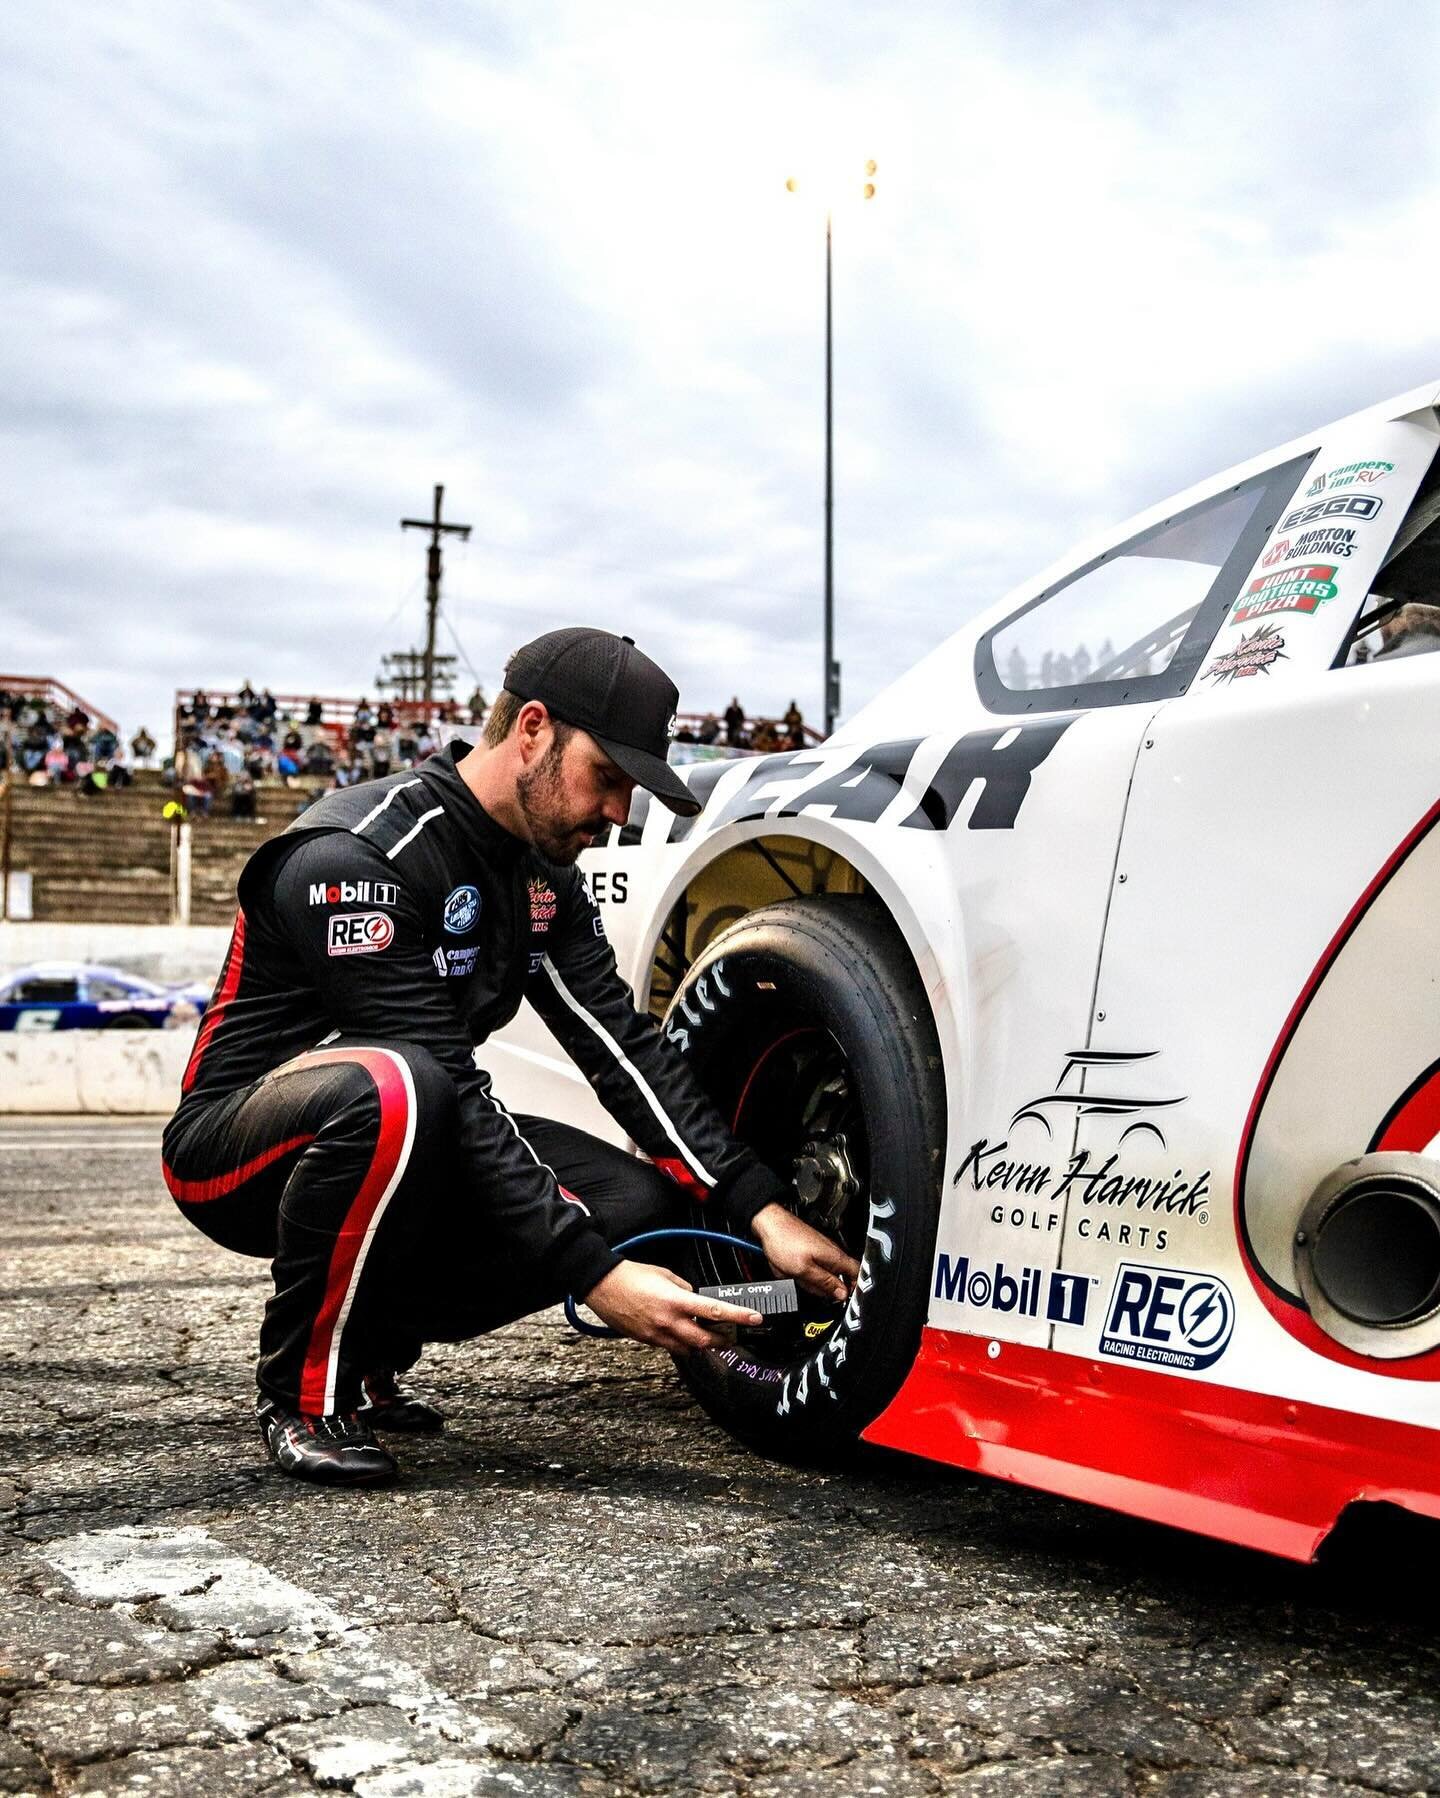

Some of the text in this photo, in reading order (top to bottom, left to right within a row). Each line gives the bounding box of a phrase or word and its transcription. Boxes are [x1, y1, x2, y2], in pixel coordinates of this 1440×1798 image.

[1328, 461, 1395, 478] campers
[1329, 470, 1385, 488] inn RV
[1295, 528, 1356, 546] MORTON
[1285, 542, 1357, 561] BUILDINGS
[1263, 567, 1315, 589] HUNT
[1237, 581, 1330, 608] BROTHERS
[1246, 595, 1299, 618] PIZZA
[310, 881, 370, 905] Mobil
[953, 1138, 1212, 1217] Kevin Harvick
[991, 1206, 1168, 1251] GOLF CARTS
[934, 1253, 1042, 1317] Mobil
[1103, 1340, 1196, 1368] RACING ELECTRONICS
[736, 1360, 760, 1380] RACE
